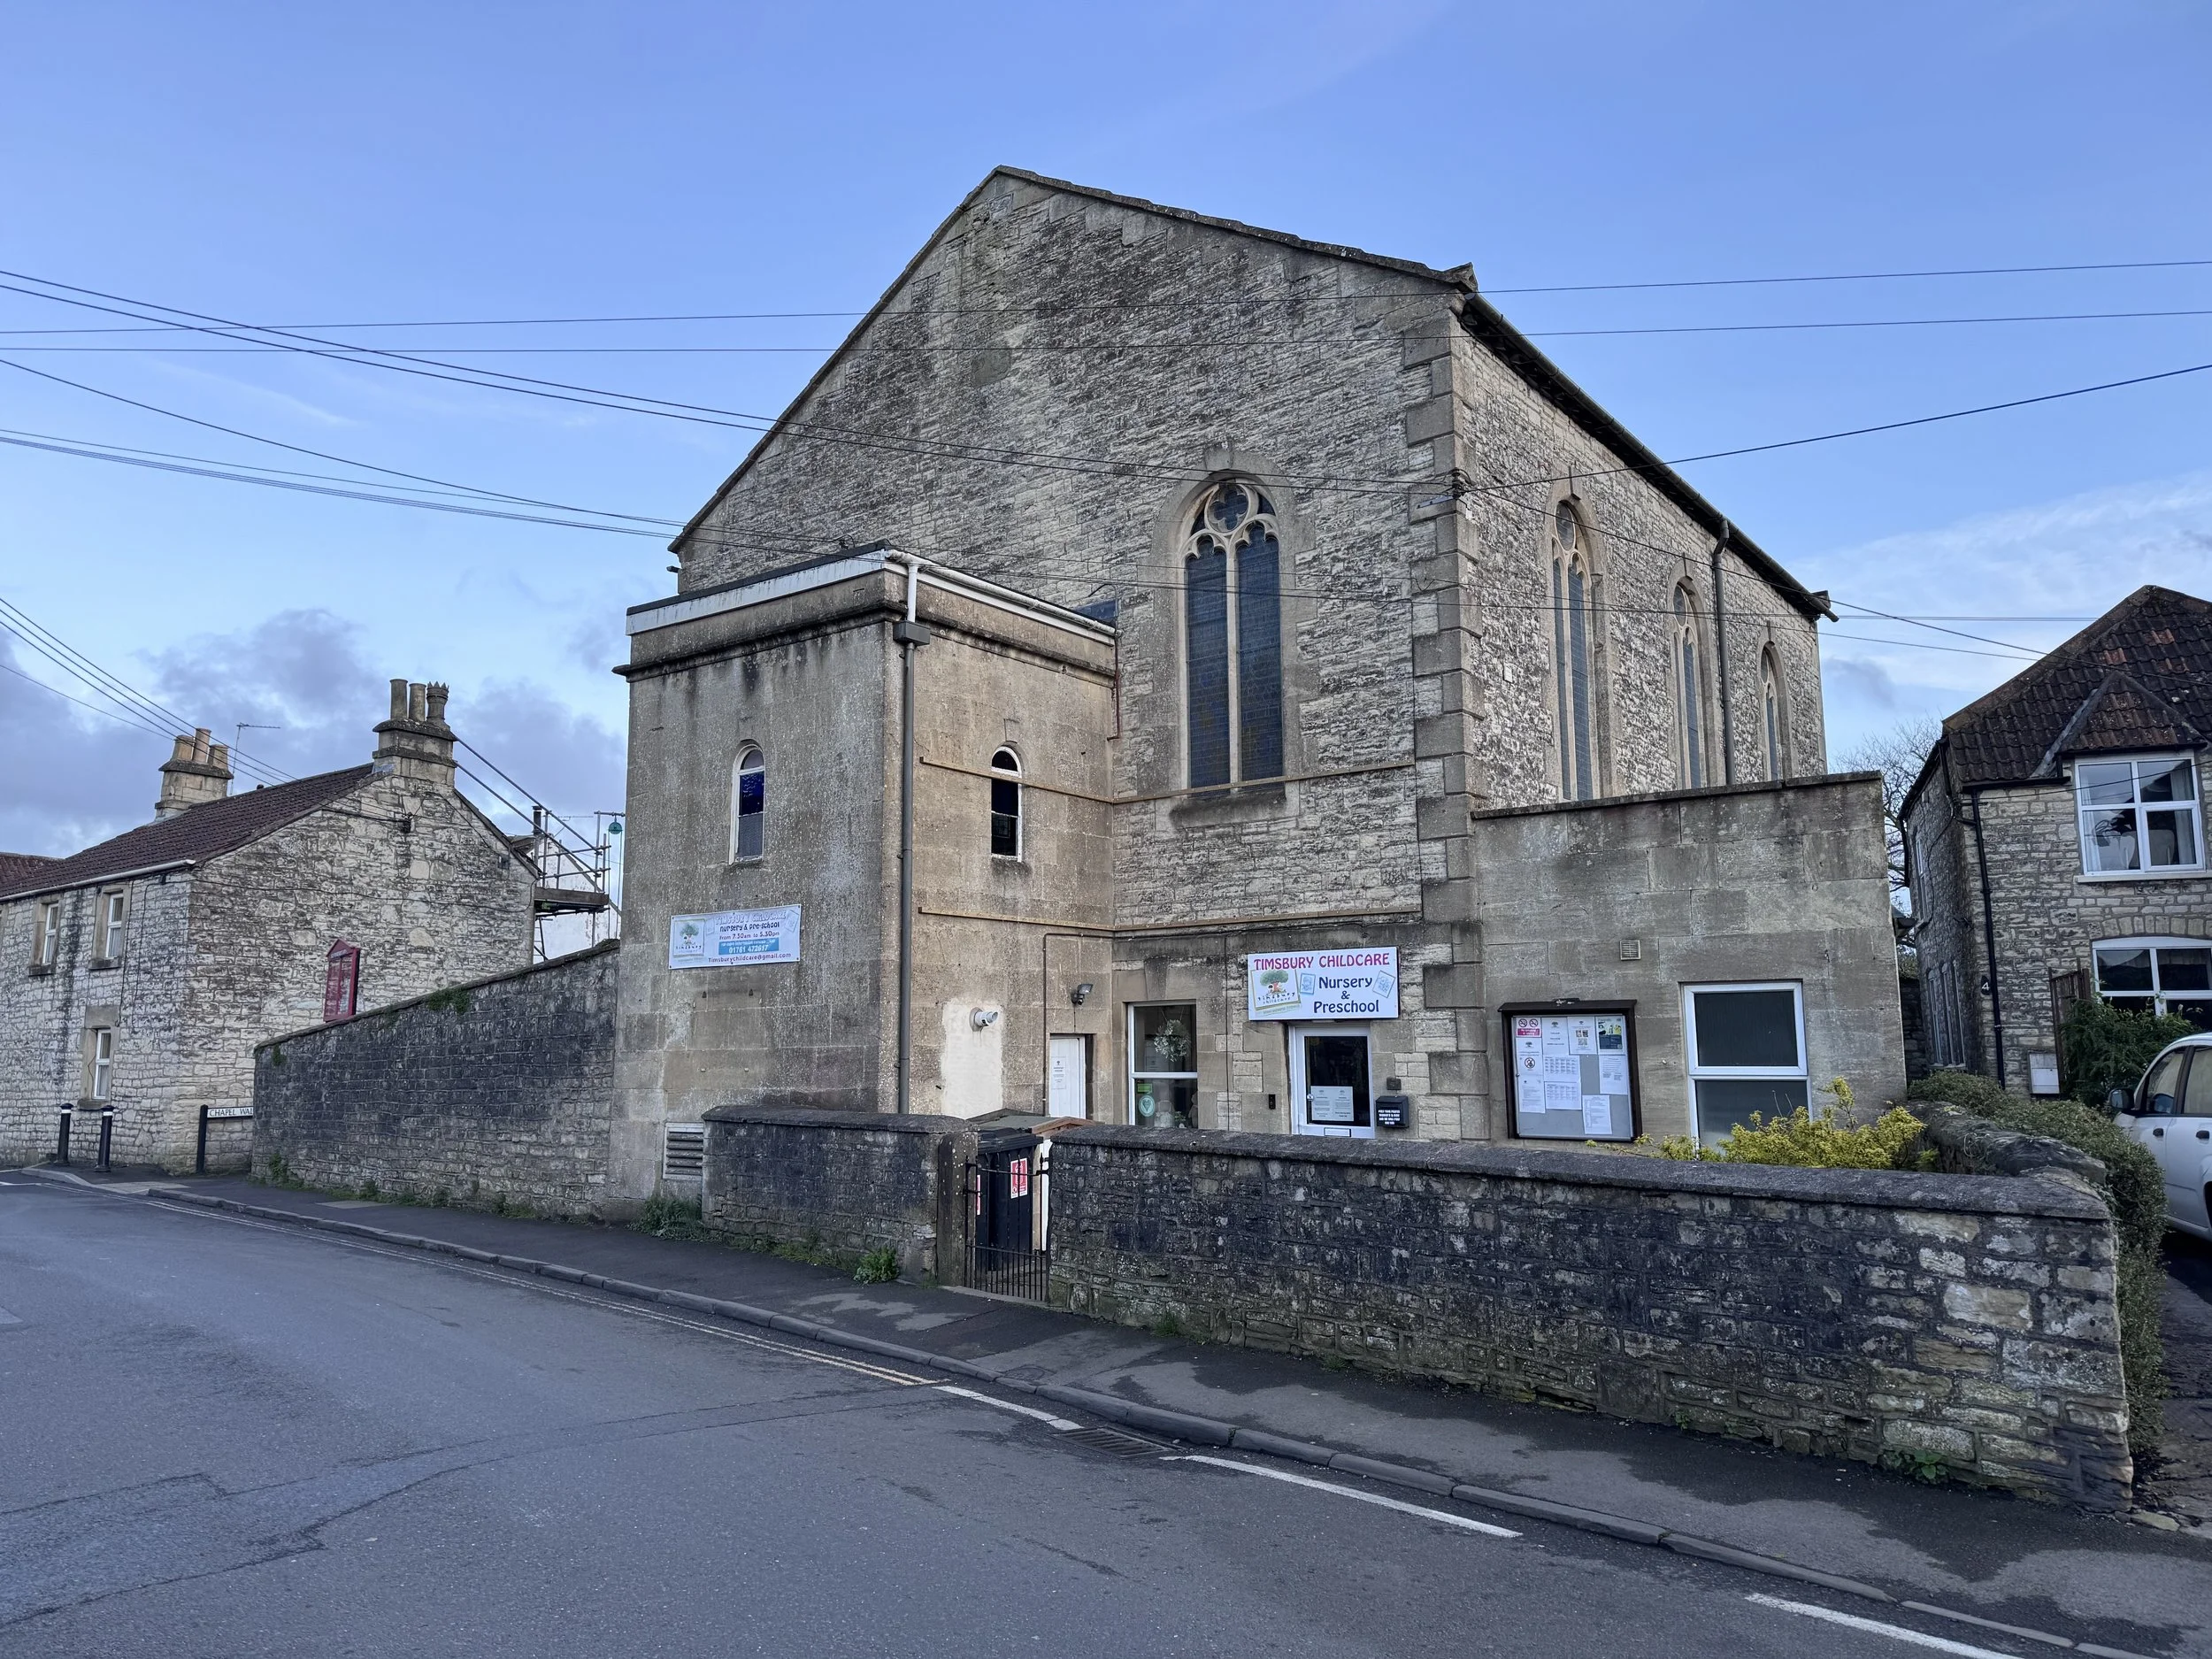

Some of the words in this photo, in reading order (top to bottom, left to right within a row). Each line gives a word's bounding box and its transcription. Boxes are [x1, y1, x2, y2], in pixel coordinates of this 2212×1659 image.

[719, 924, 743, 933] nursery
[749, 921, 780, 930] pre-school
[1254, 956, 1314, 971] TIMSBURY
[1318, 952, 1390, 968] CHILDCARE
[1318, 976, 1372, 989] Nursery
[1982, 981, 1990, 991] 4
[1340, 990, 1351, 1000] &
[1313, 1000, 1379, 1014] Preschool
